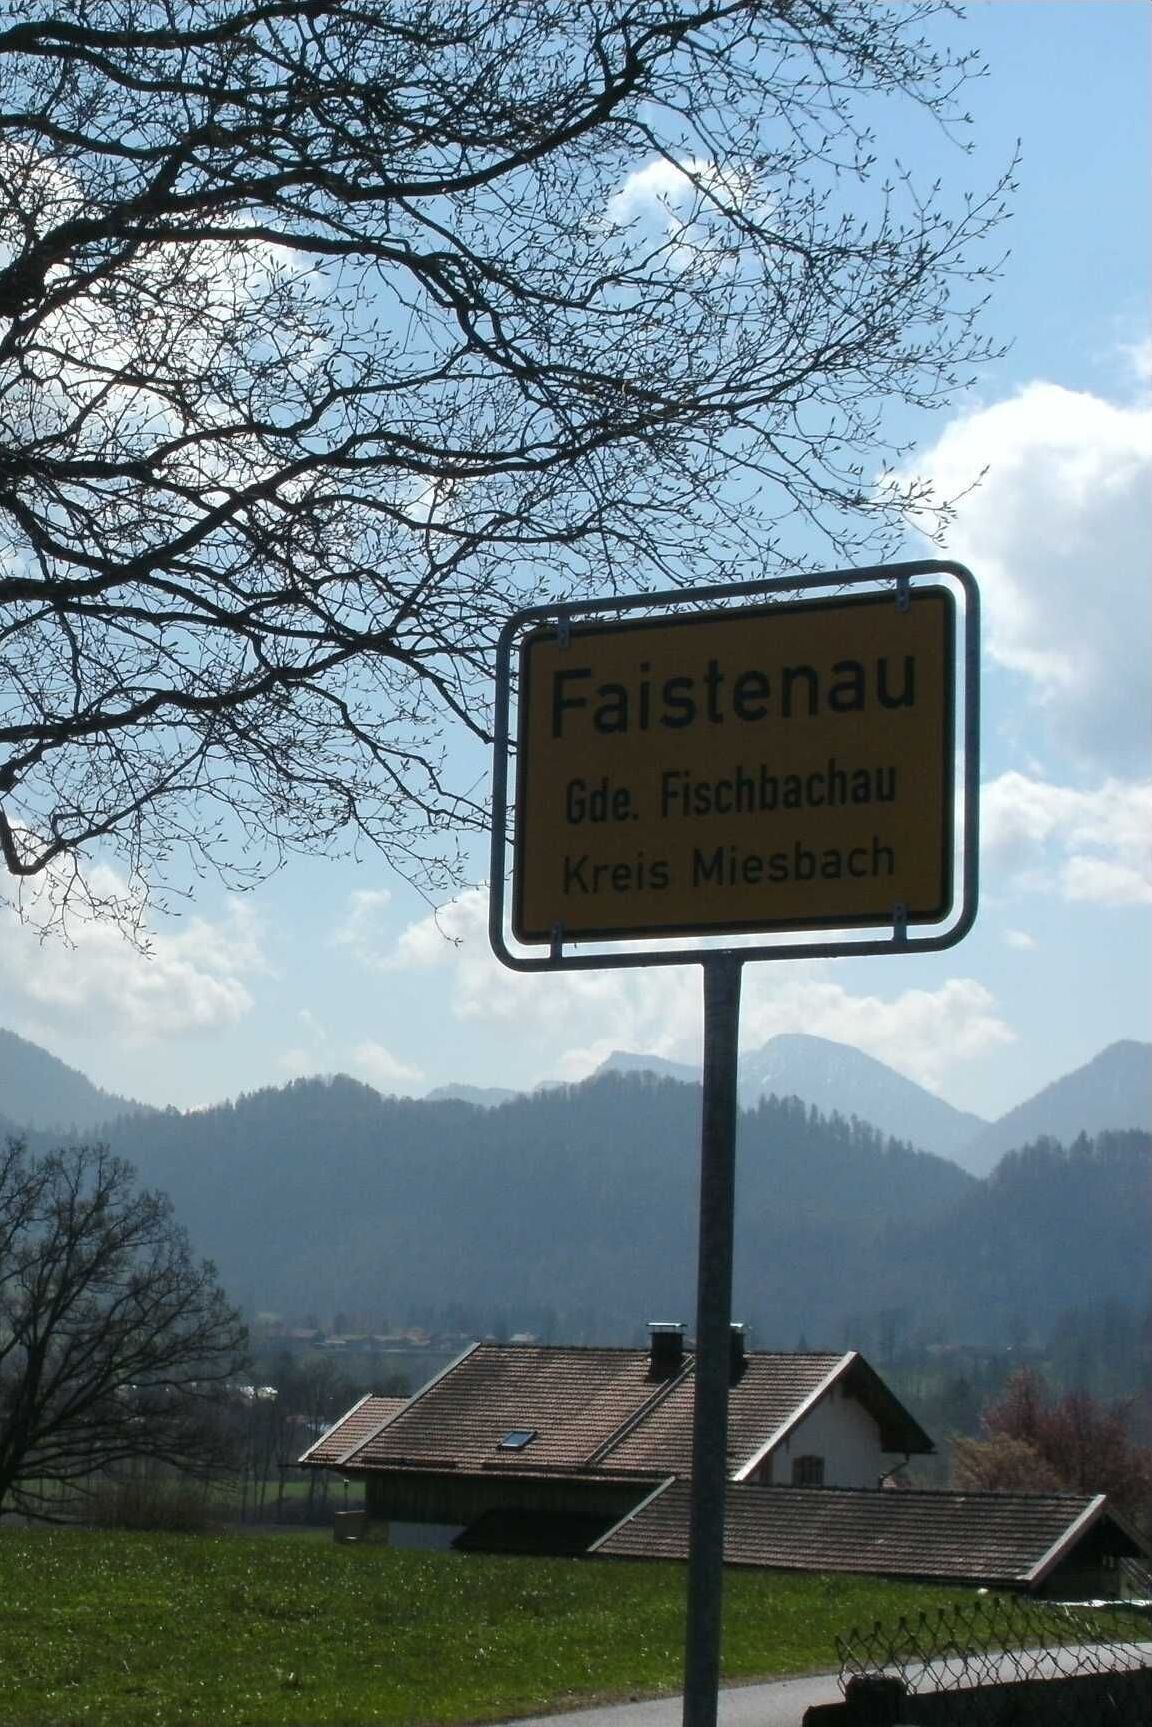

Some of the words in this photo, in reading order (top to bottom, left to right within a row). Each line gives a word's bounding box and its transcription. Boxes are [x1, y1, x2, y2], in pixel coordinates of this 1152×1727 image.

[551, 655, 915, 738] Faistenau
[565, 777, 639, 825] Gde.
[661, 758, 897, 819] Fischbachau
[562, 852, 670, 896] Kreis
[692, 836, 896, 888] Miesbach
